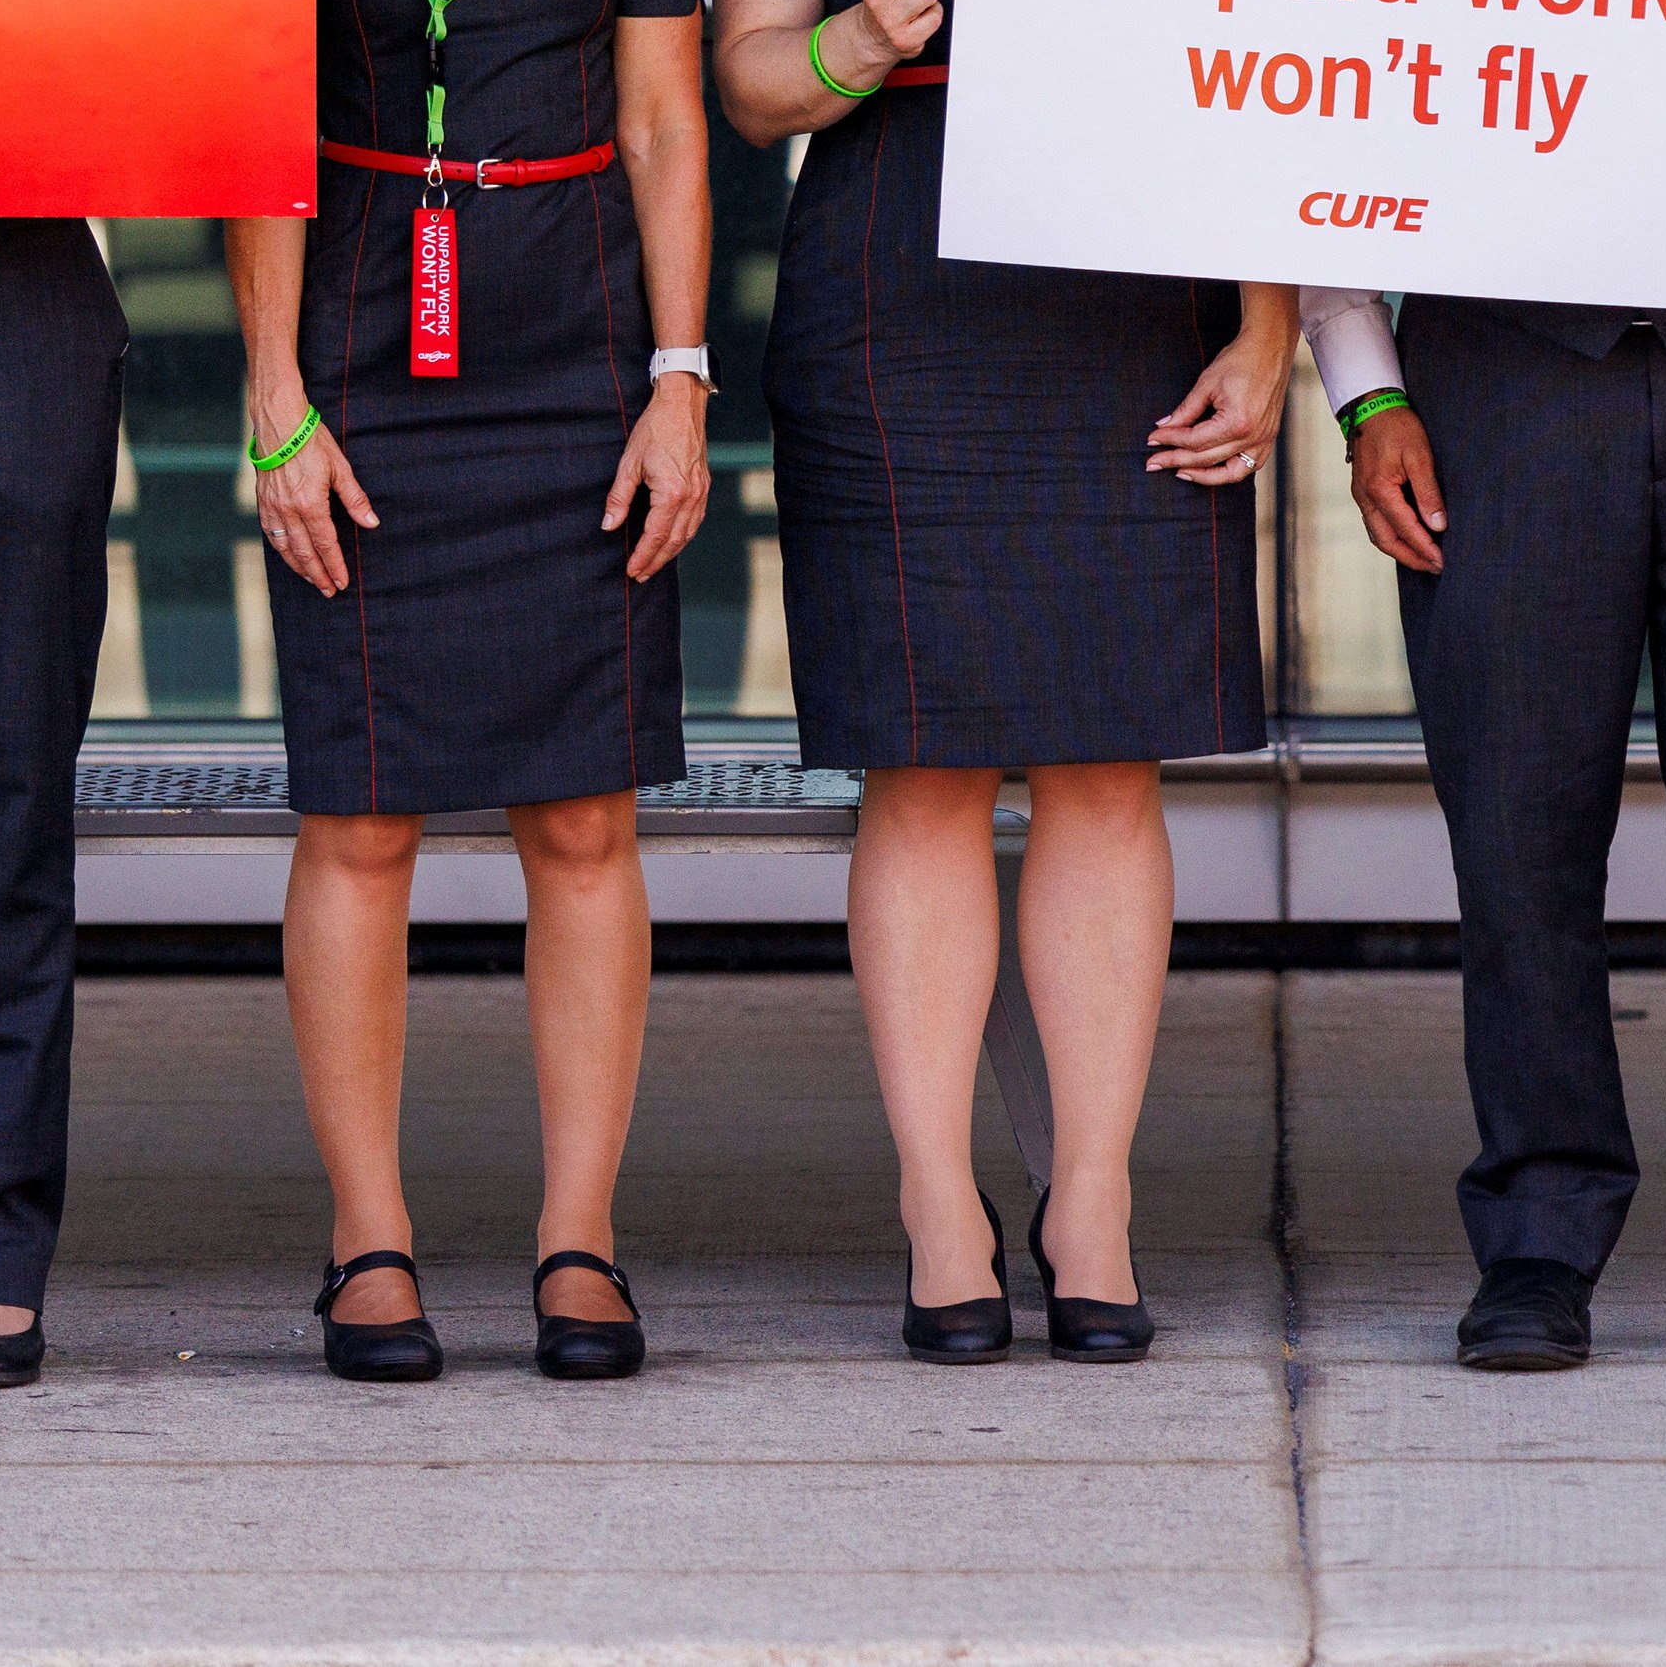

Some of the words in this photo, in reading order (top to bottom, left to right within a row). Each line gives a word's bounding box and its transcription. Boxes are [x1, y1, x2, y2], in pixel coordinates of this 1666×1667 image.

[1477, 44, 1589, 154] fly
[1298, 191, 1430, 233] CUPE
[438, 226, 450, 284] UNPAID
[421, 298, 436, 334] FLY
[438, 288, 450, 336] WORK
[278, 448, 293, 459] No
[291, 425, 311, 448] More
